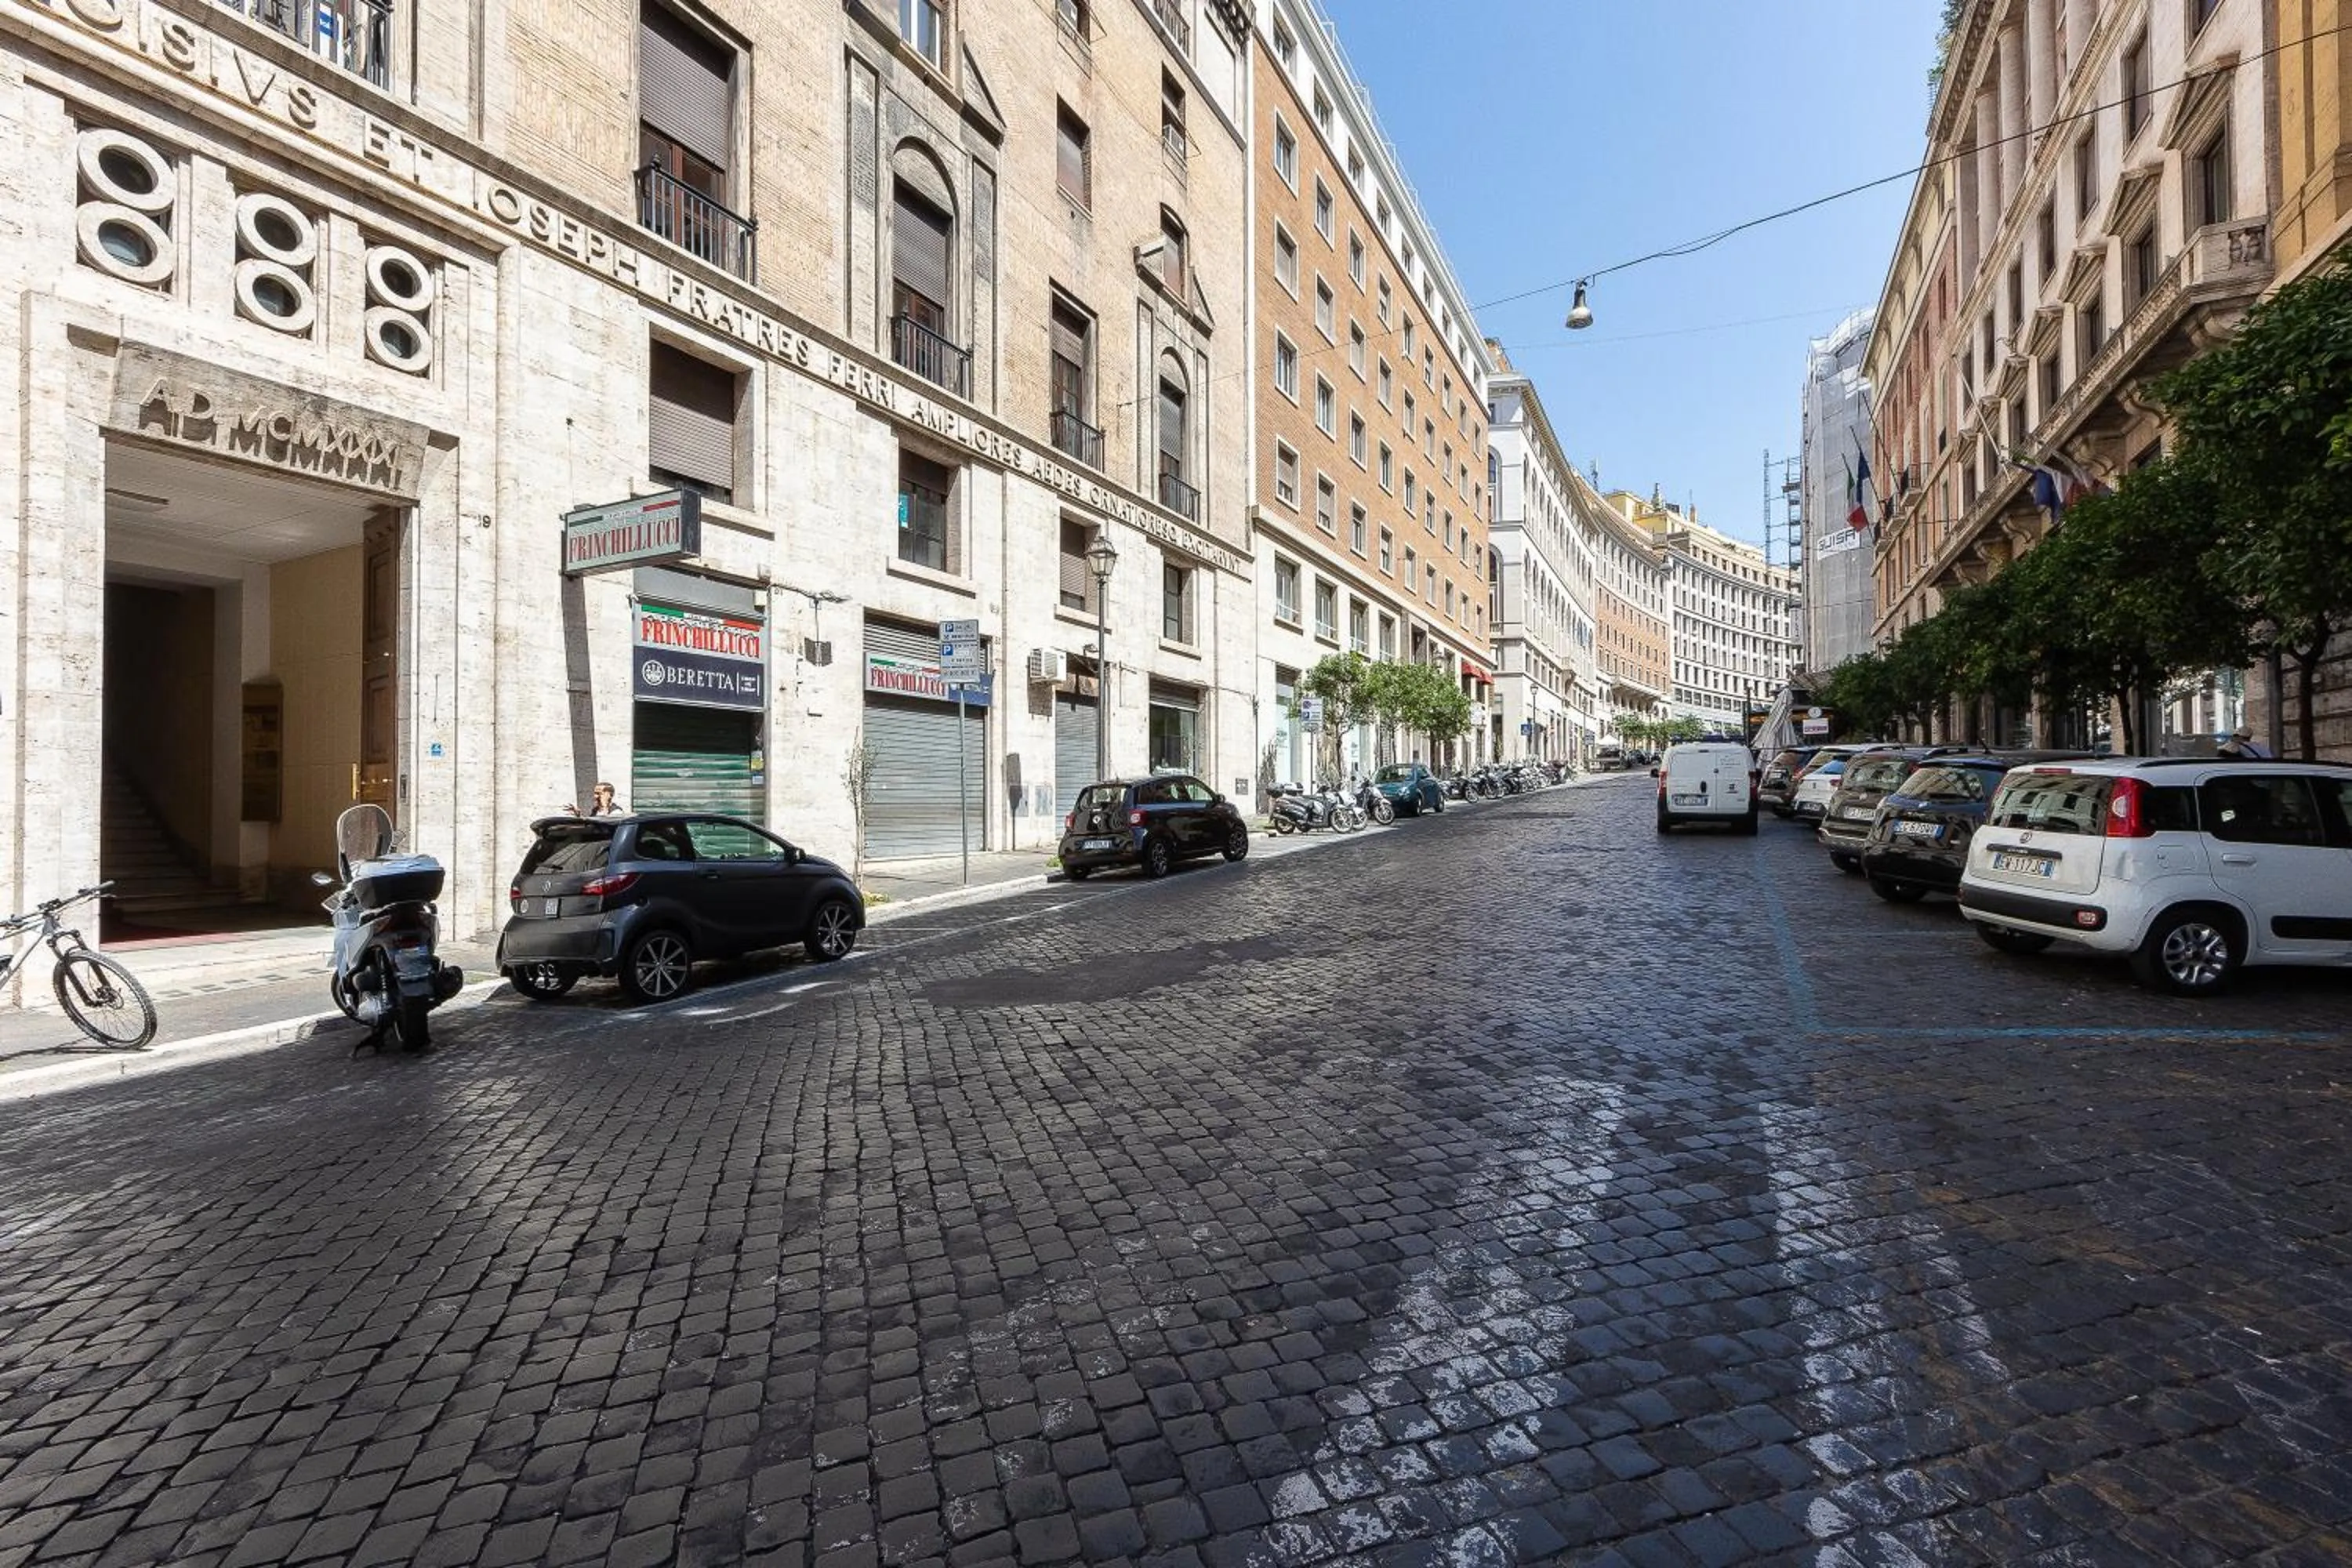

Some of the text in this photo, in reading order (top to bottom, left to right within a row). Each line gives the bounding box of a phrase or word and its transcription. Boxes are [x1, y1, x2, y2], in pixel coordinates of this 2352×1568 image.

[363, 114, 433, 185] ET
[473, 170, 640, 287] IOSEPH
[667, 269, 809, 368] FRATRES
[829, 350, 895, 409] FERRI
[911, 401, 1022, 468] AMPLIORES
[1033, 456, 1081, 496] AEDES
[568, 517, 680, 563] FRINCHILLUCCI
[641, 617, 760, 658] FRINCHILLUCCI
[667, 666, 735, 691] BERETTA
